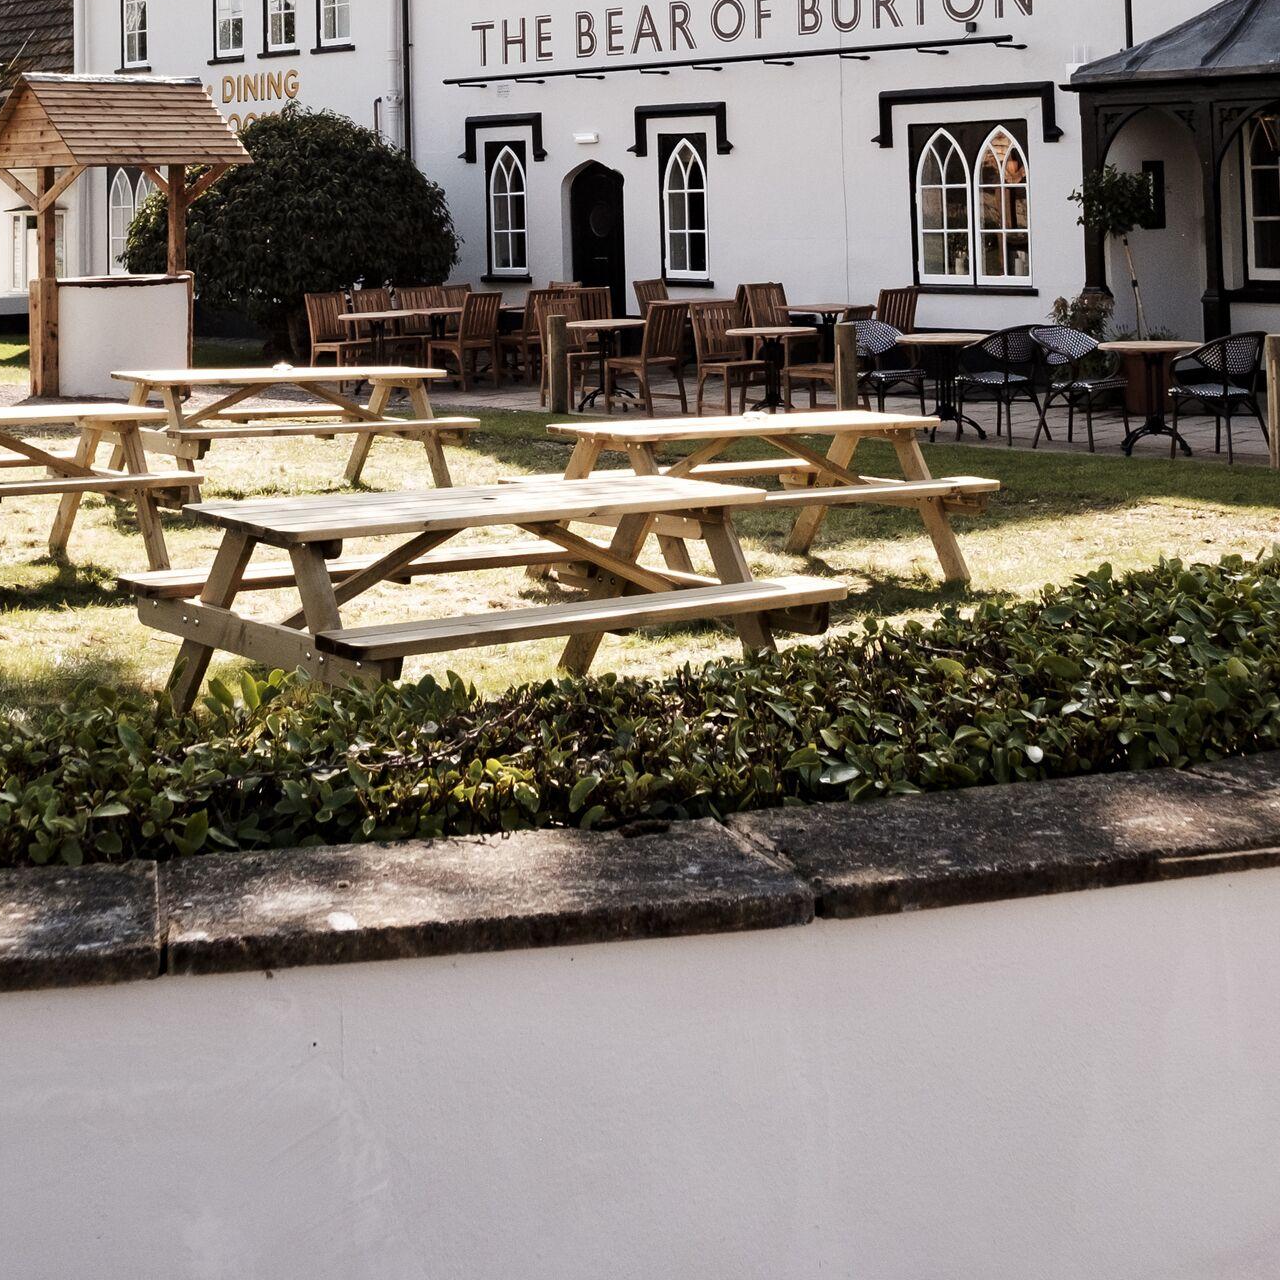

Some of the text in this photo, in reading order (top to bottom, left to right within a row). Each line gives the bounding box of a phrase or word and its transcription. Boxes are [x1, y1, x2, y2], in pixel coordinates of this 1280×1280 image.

[471, 14, 554, 67] THE
[575, 1, 698, 58] BEAR
[222, 68, 300, 104] DINING
